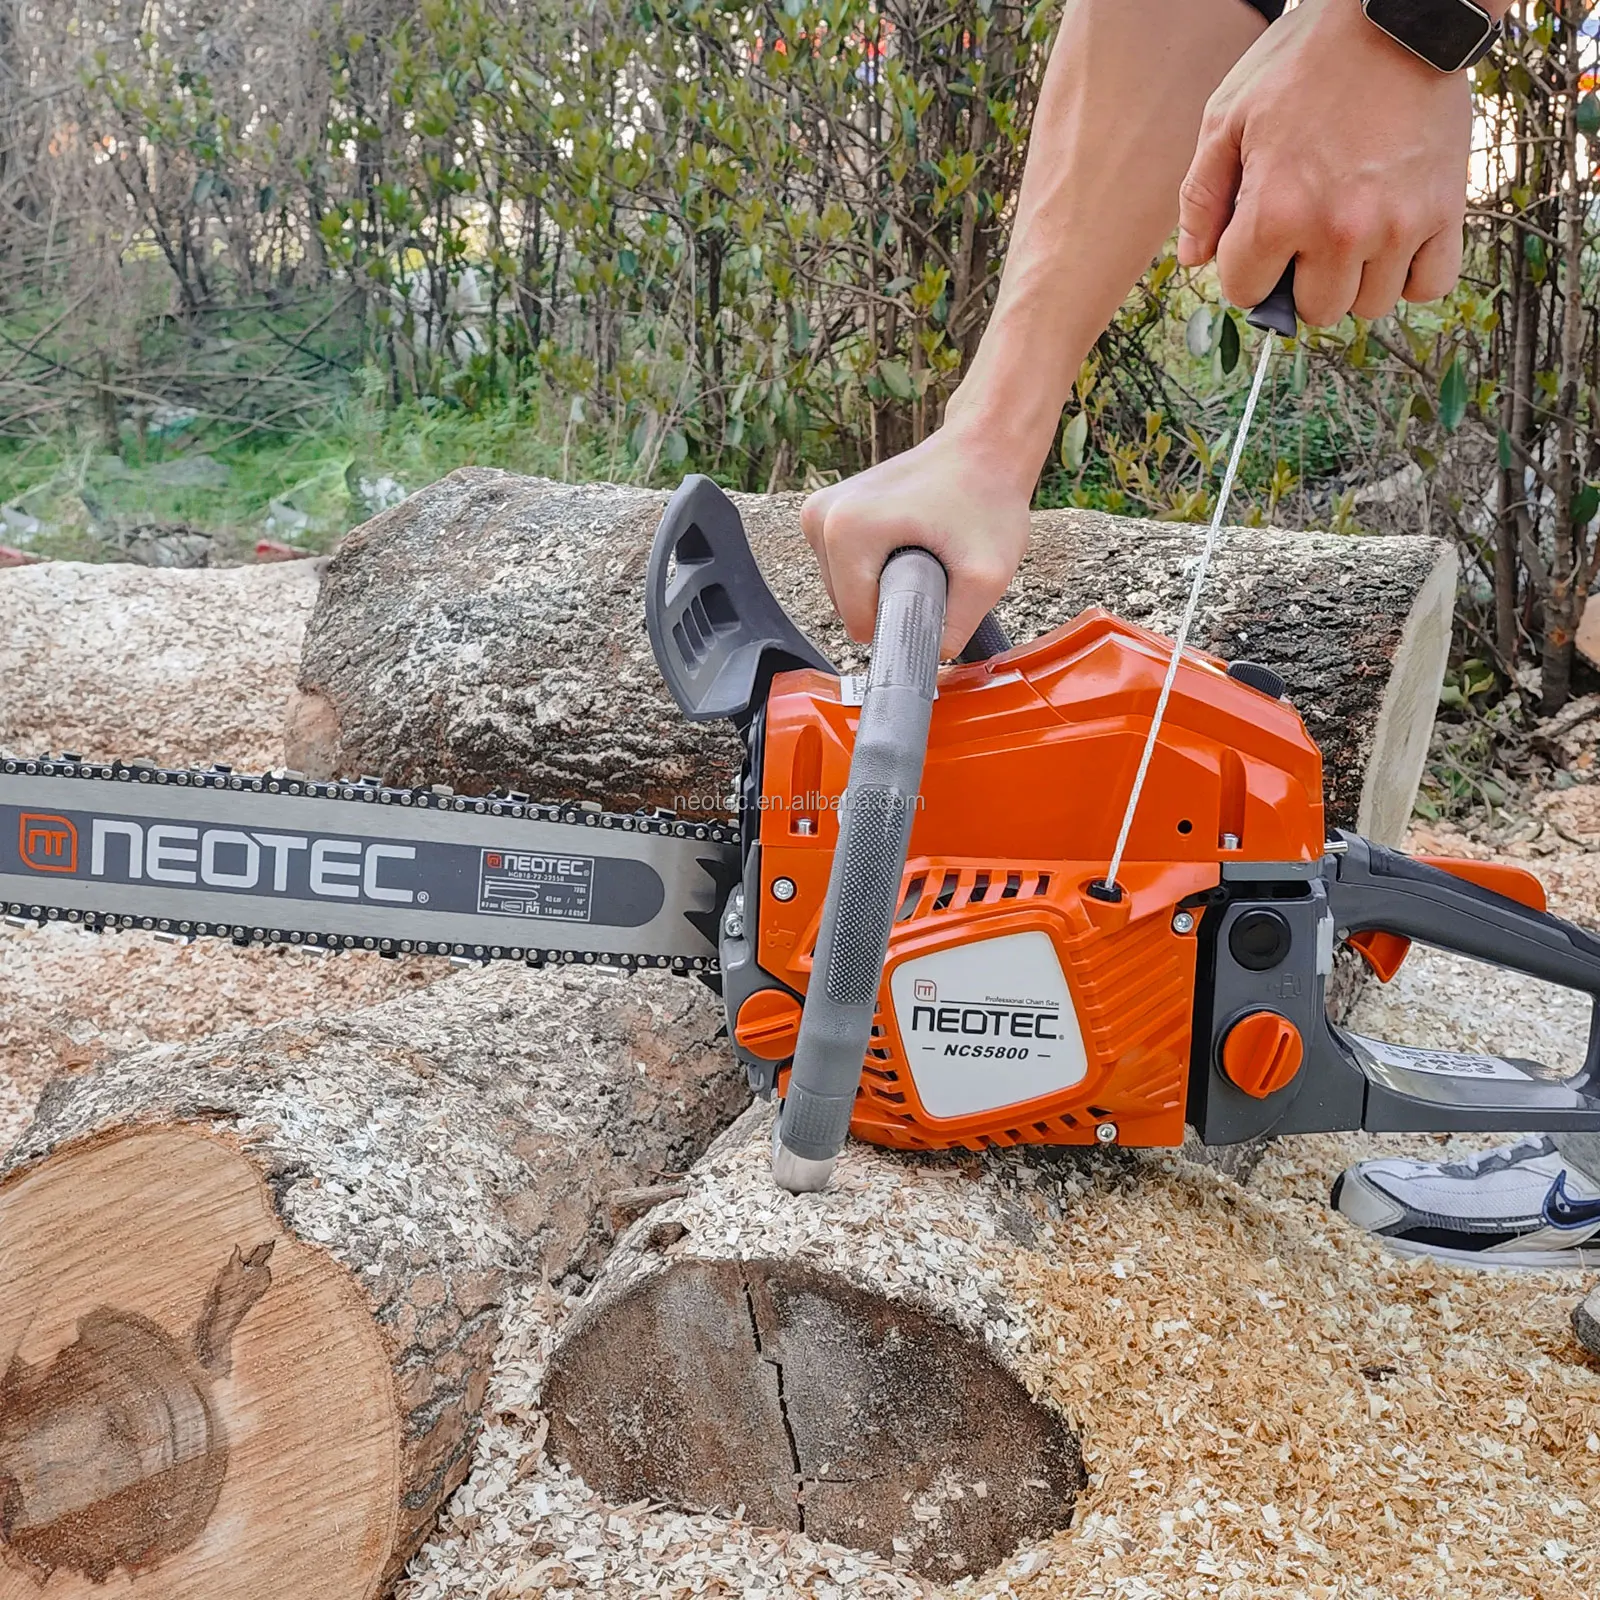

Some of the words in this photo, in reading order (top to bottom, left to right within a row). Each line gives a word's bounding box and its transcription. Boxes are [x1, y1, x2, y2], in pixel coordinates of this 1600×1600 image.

[985, 995, 1025, 1004] Professional
[1025, 997, 1045, 1006] Chain
[943, 1044, 1029, 1060] NCS5800
